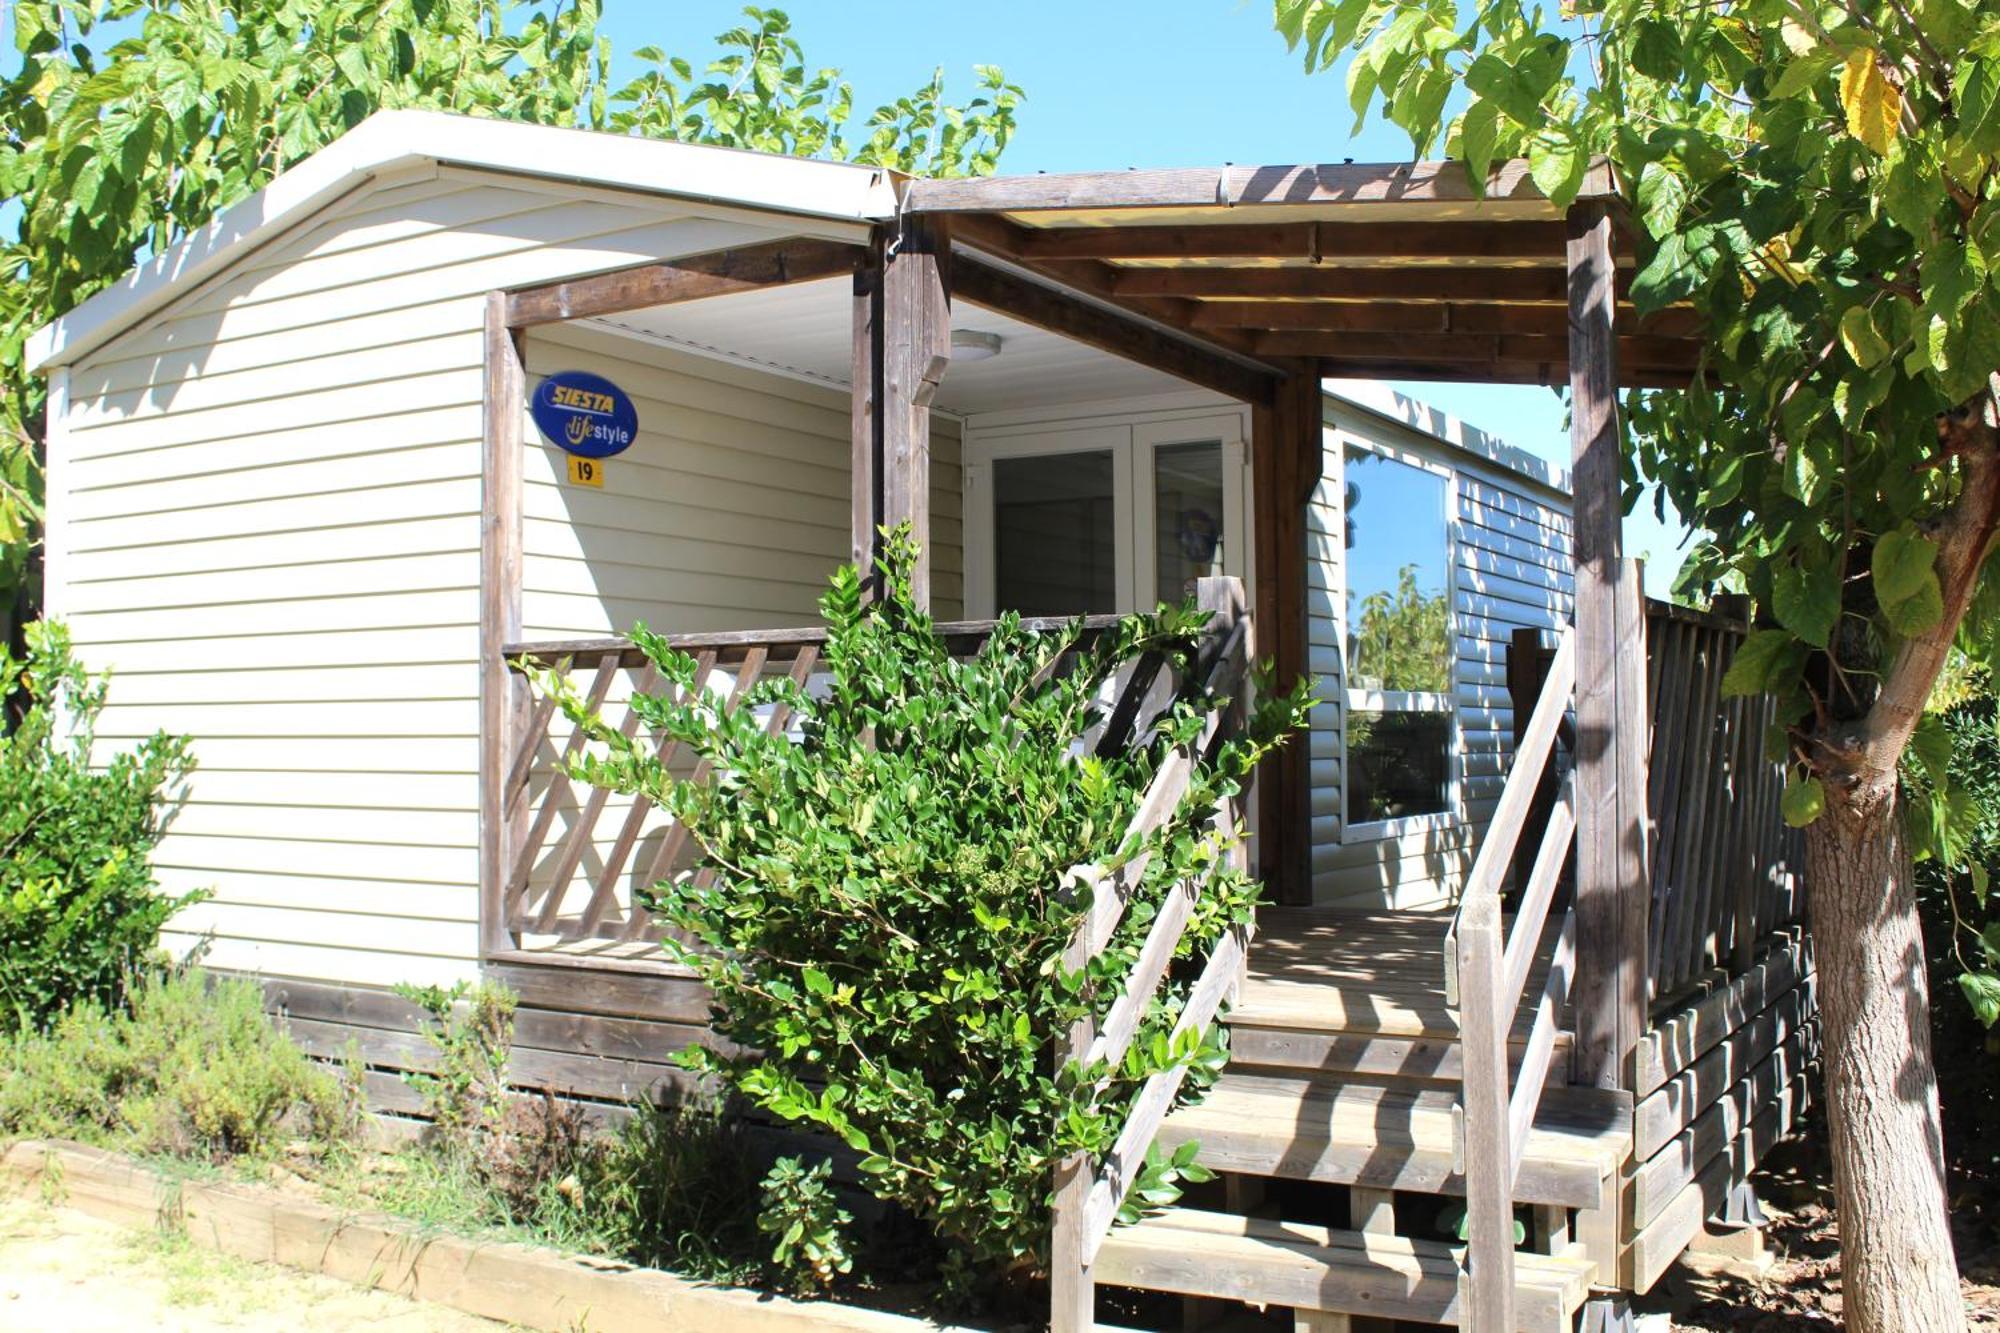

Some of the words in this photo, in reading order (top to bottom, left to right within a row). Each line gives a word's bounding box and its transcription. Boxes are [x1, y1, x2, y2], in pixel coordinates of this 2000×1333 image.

[552, 385, 615, 413] SIESTA
[565, 415, 629, 445] lifestyle
[577, 461, 593, 480] 19
